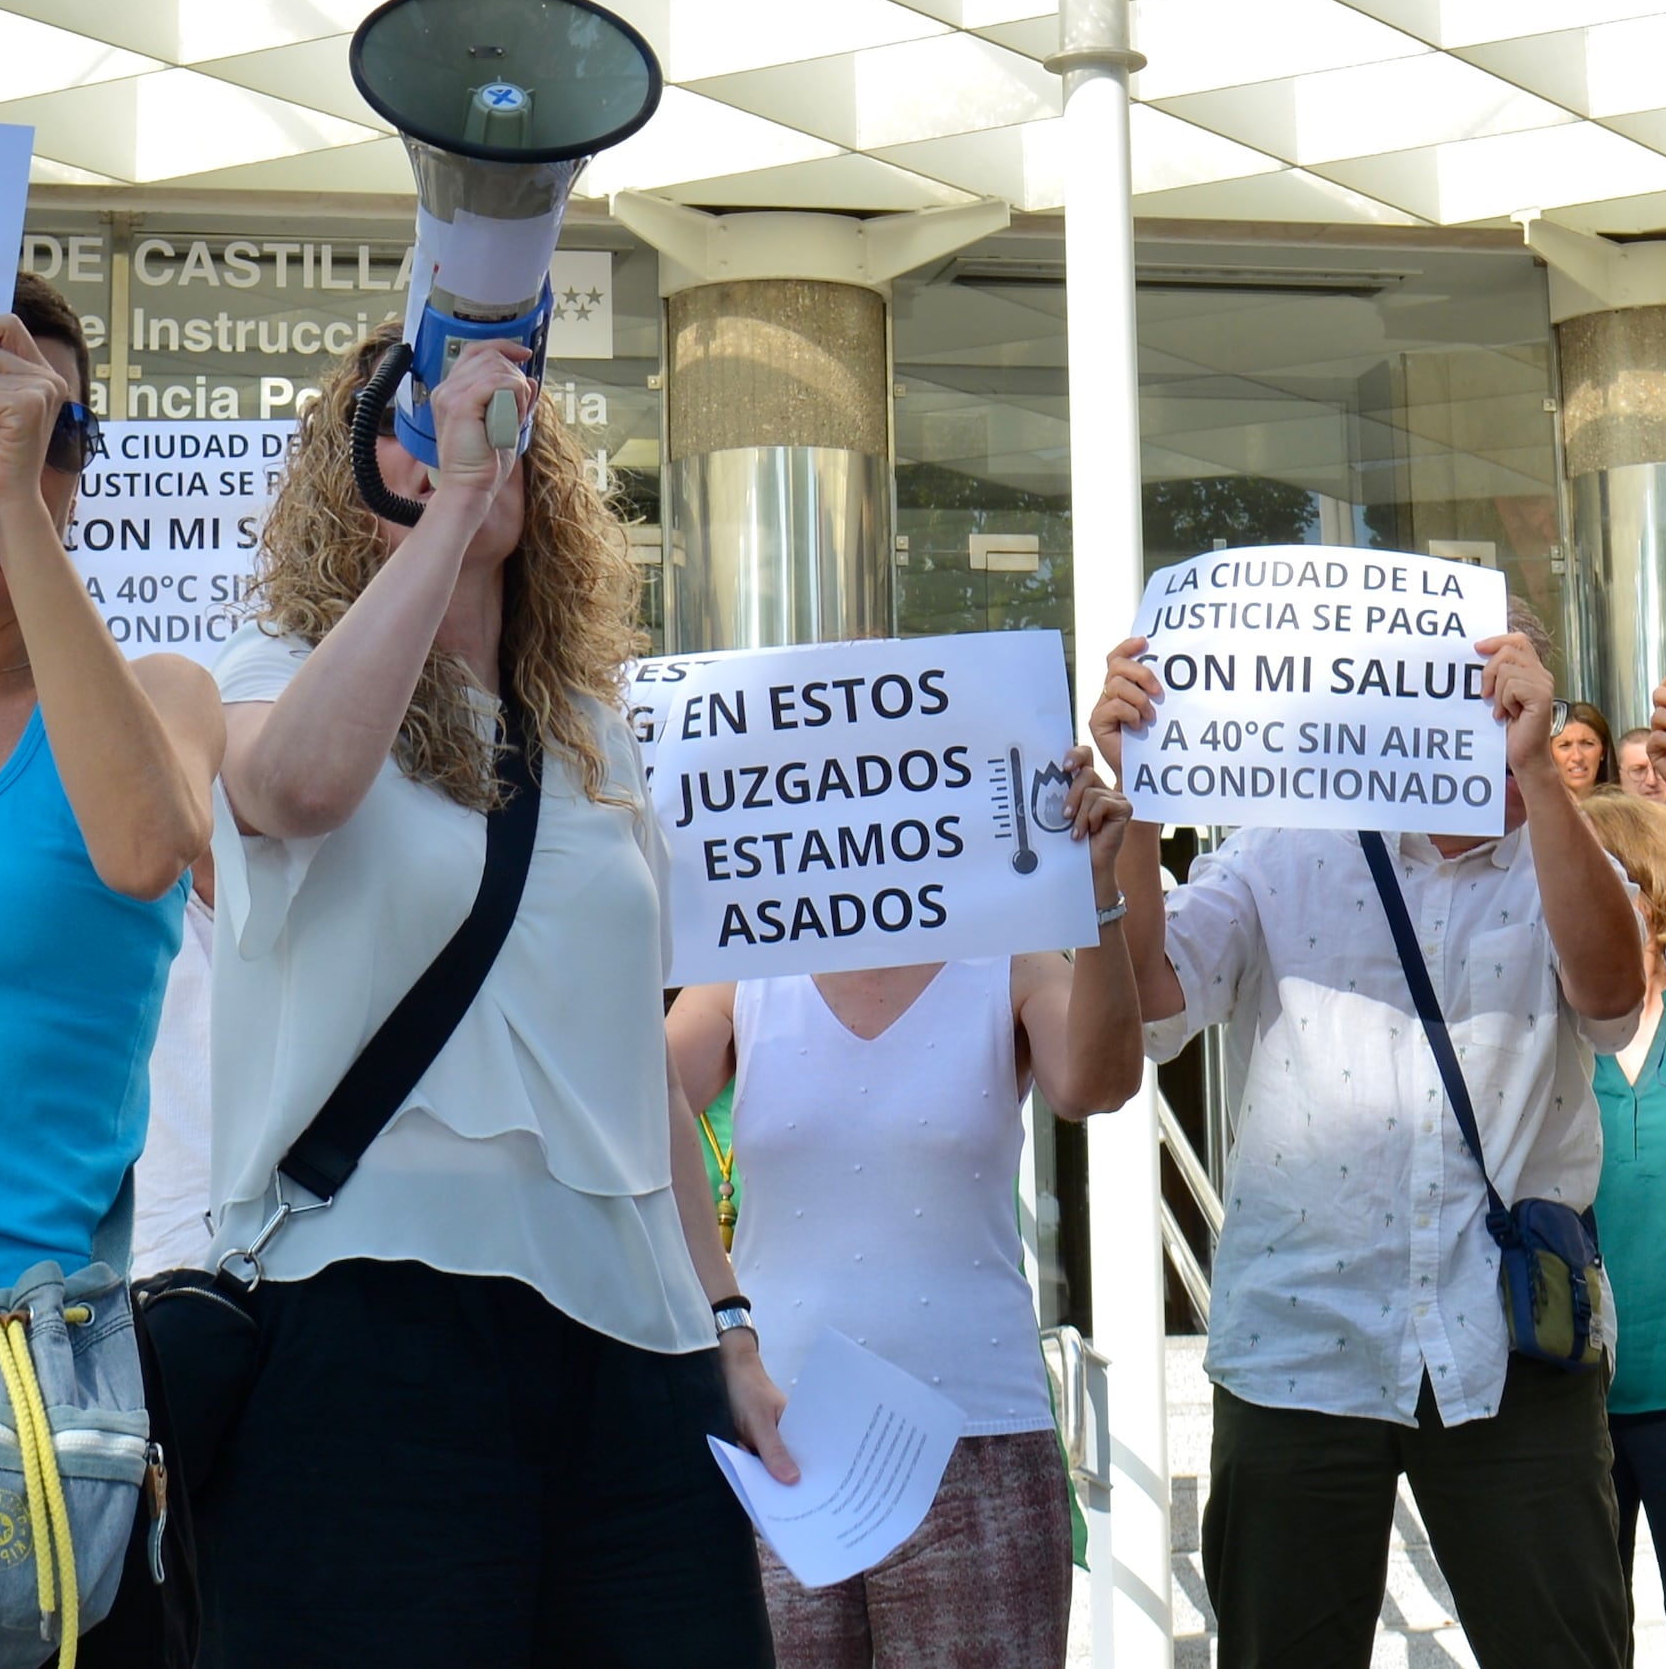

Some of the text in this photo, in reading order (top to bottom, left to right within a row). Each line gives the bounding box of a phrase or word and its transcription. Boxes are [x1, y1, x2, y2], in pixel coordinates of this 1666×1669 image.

[133, 307, 398, 354] Instrucci
[121, 434, 249, 459] CIUDAD
[219, 471, 254, 496] SE
[169, 518, 220, 550] MI
[87, 577, 105, 604] A
[116, 575, 197, 603] 40°C
[1165, 562, 1463, 599] LA CIUDAD DE LA
[1147, 602, 1466, 638] JUSTICIA SE PAGA
[1256, 655, 1311, 693] MI
[682, 690, 747, 741] EN
[769, 669, 949, 731] ESTOS
[1161, 720, 1473, 761] A 40°C SIN AIRE
[676, 746, 972, 828] JUZGADOS
[1134, 763, 1492, 807] ACONDICIONADO
[703, 815, 964, 881] ESTAMOS
[718, 884, 947, 948] ASADOS
